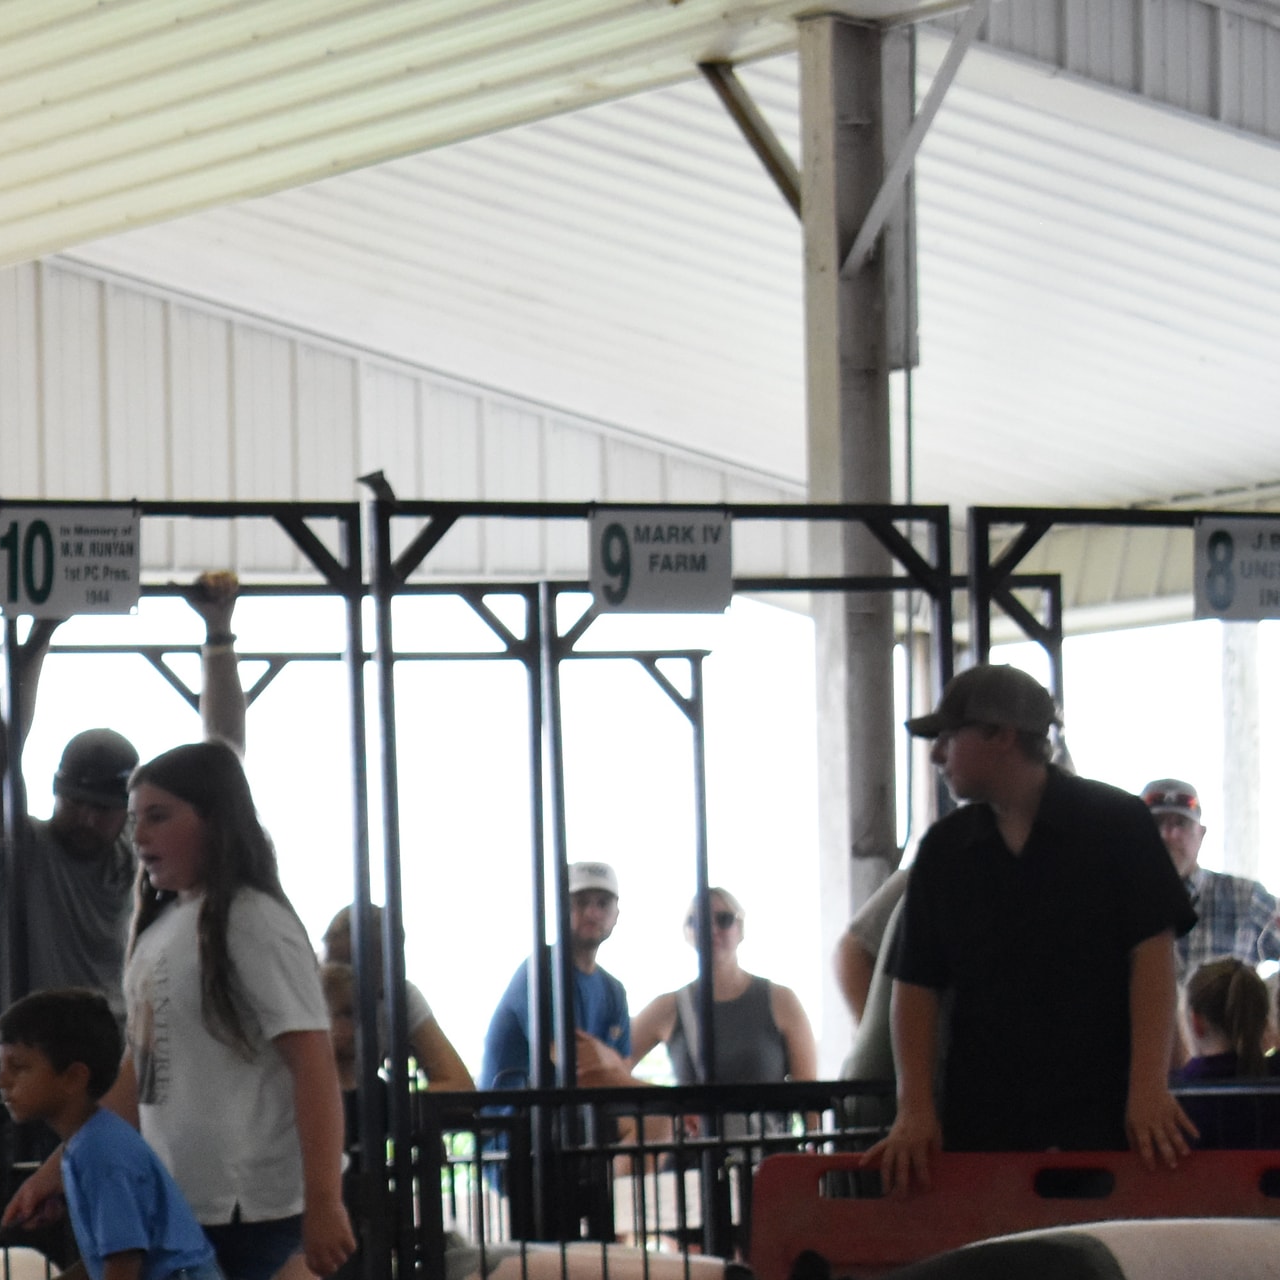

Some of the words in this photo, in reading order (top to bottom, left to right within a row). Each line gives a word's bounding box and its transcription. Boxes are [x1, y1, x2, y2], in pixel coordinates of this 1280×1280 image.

[73, 525, 118, 539] Memory
[121, 525, 133, 536] of
[633, 525, 696, 545] MARK
[702, 525, 723, 545] IV
[89, 541, 135, 558] RUNYAN
[600, 522, 632, 607] 9
[648, 553, 708, 573] FARM
[1204, 529, 1237, 613] 8
